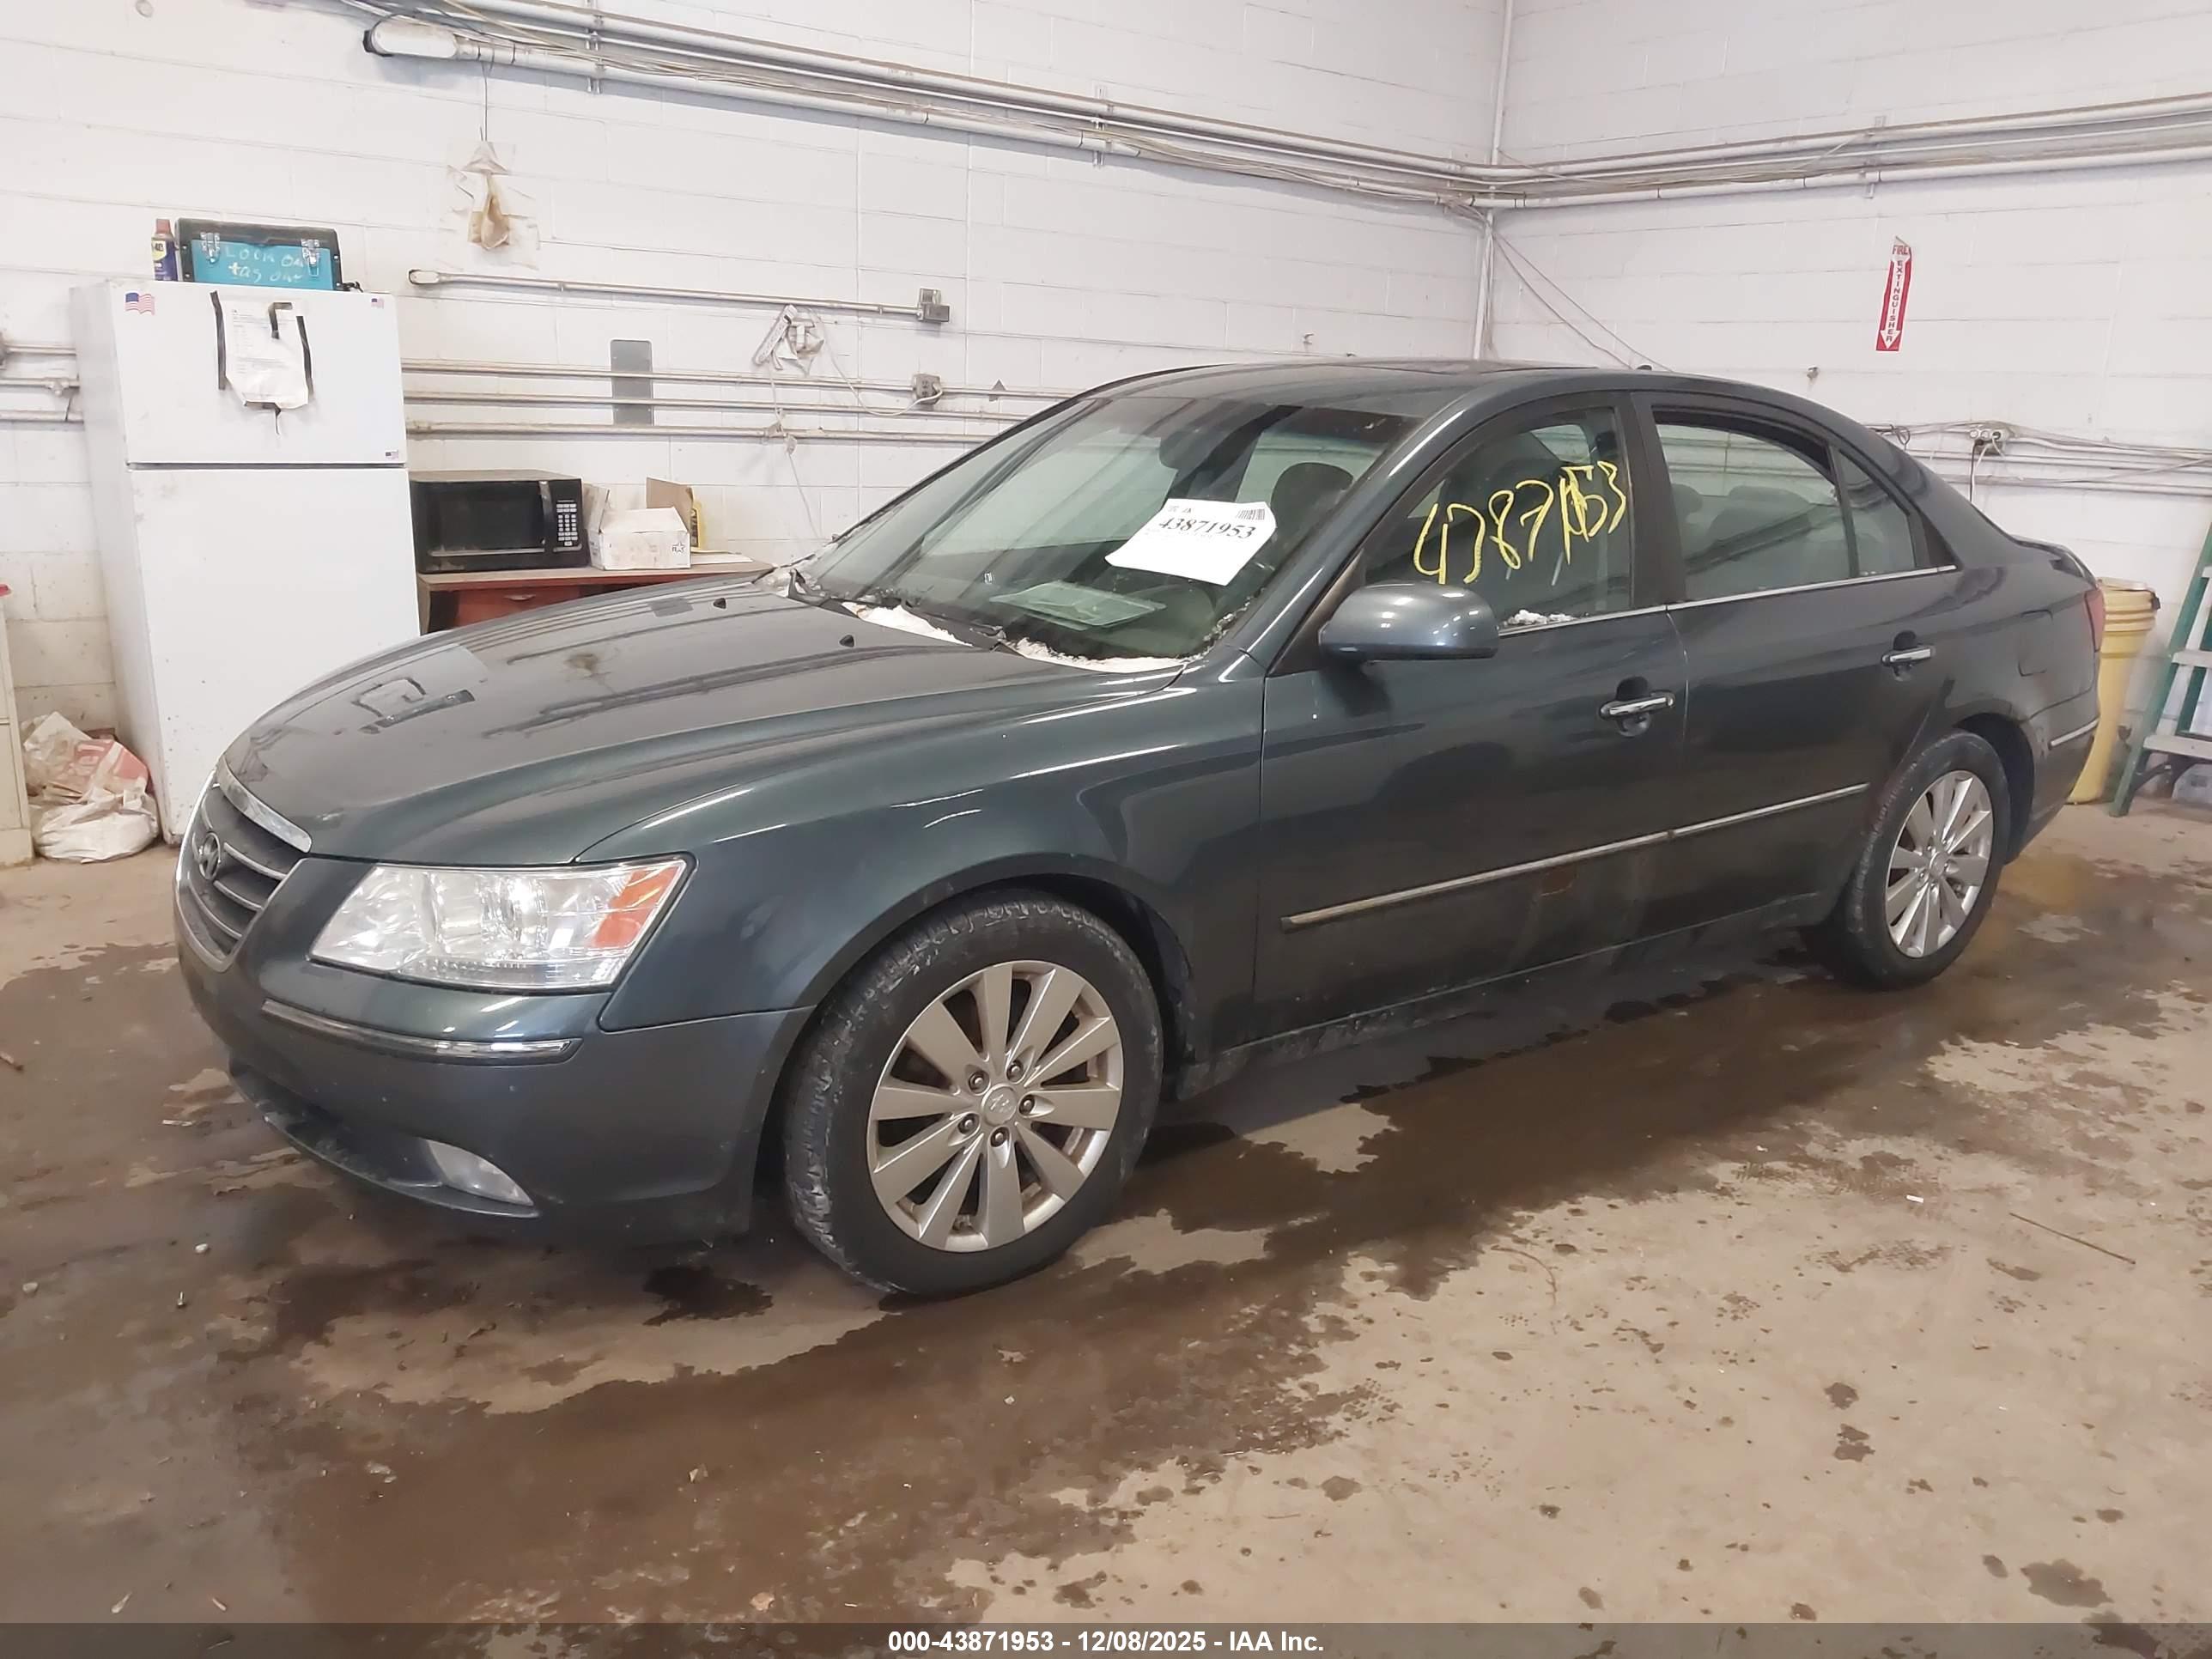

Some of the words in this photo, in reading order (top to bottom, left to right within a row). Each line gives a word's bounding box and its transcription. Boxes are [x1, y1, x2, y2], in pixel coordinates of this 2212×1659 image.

[1892, 245, 1908, 255] FIRE
[1886, 260, 1903, 342] EXTINGUISHER
[1158, 517, 1256, 539] 43871953
